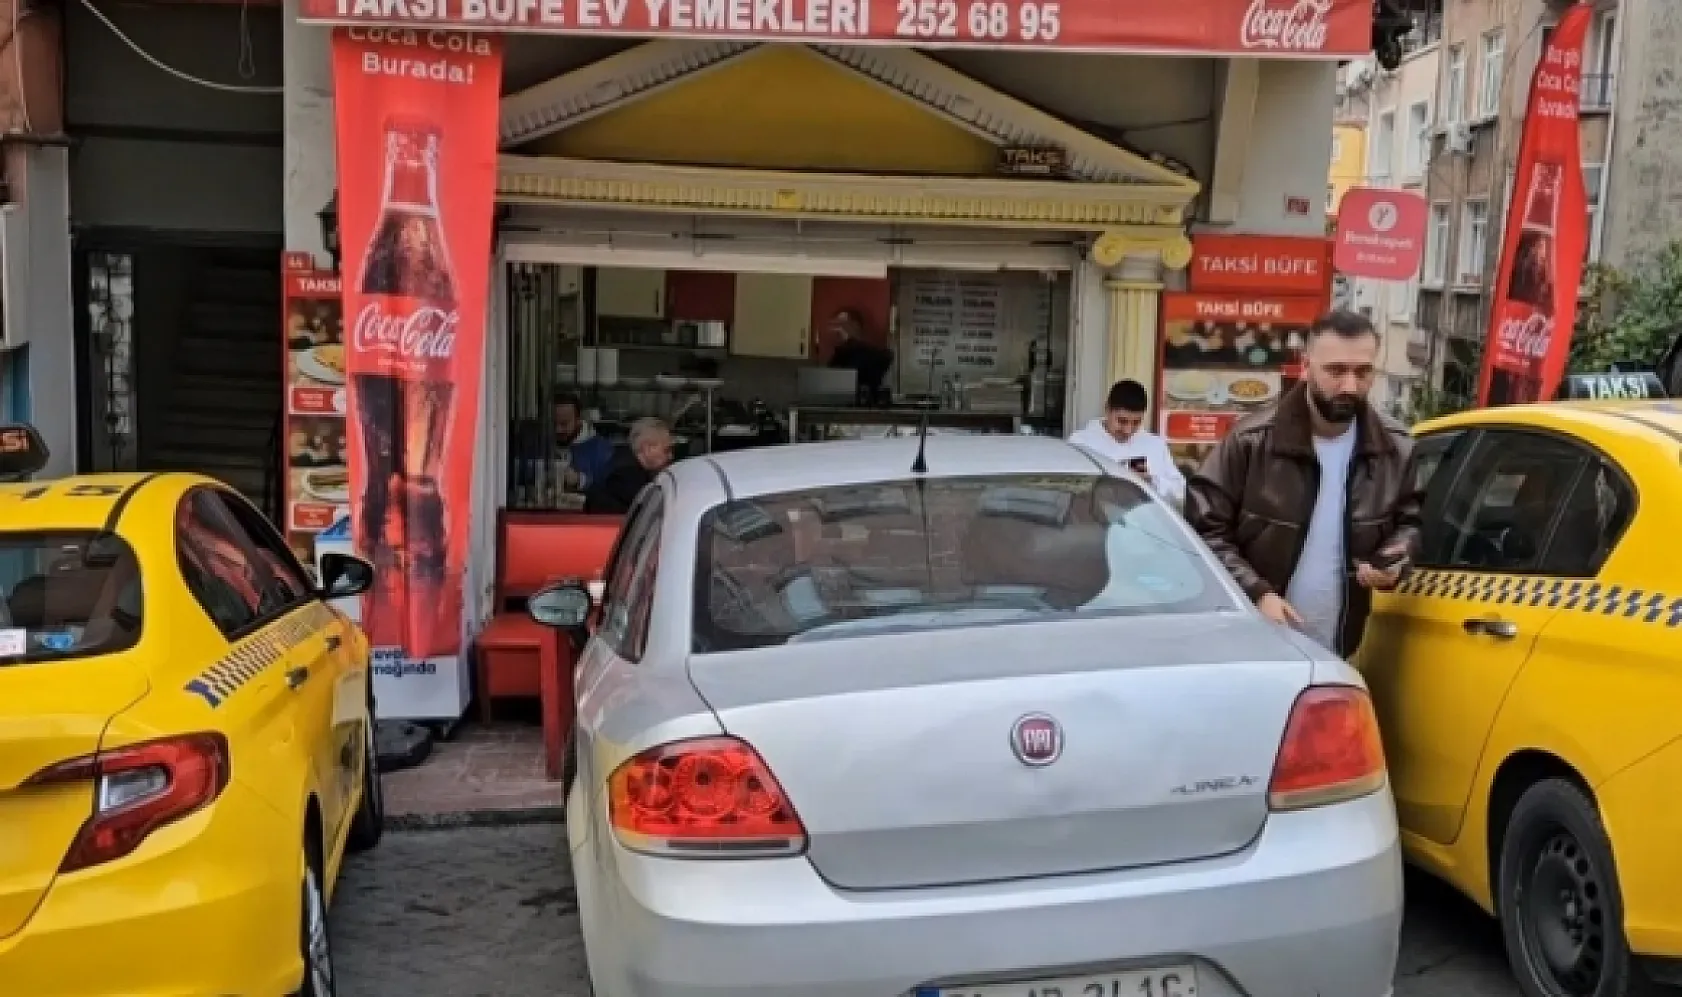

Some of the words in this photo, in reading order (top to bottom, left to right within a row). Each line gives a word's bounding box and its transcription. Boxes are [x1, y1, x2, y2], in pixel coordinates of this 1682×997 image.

[577, 0, 628, 27] EV
[896, 0, 959, 37] 252
[967, 2, 1009, 39] 68
[1019, 2, 1061, 40] 95
[426, 29, 492, 56] Cola
[361, 50, 475, 85] Burada!
[1263, 254, 1319, 276] BÜFE
[1022, 728, 1052, 752] FIAT
